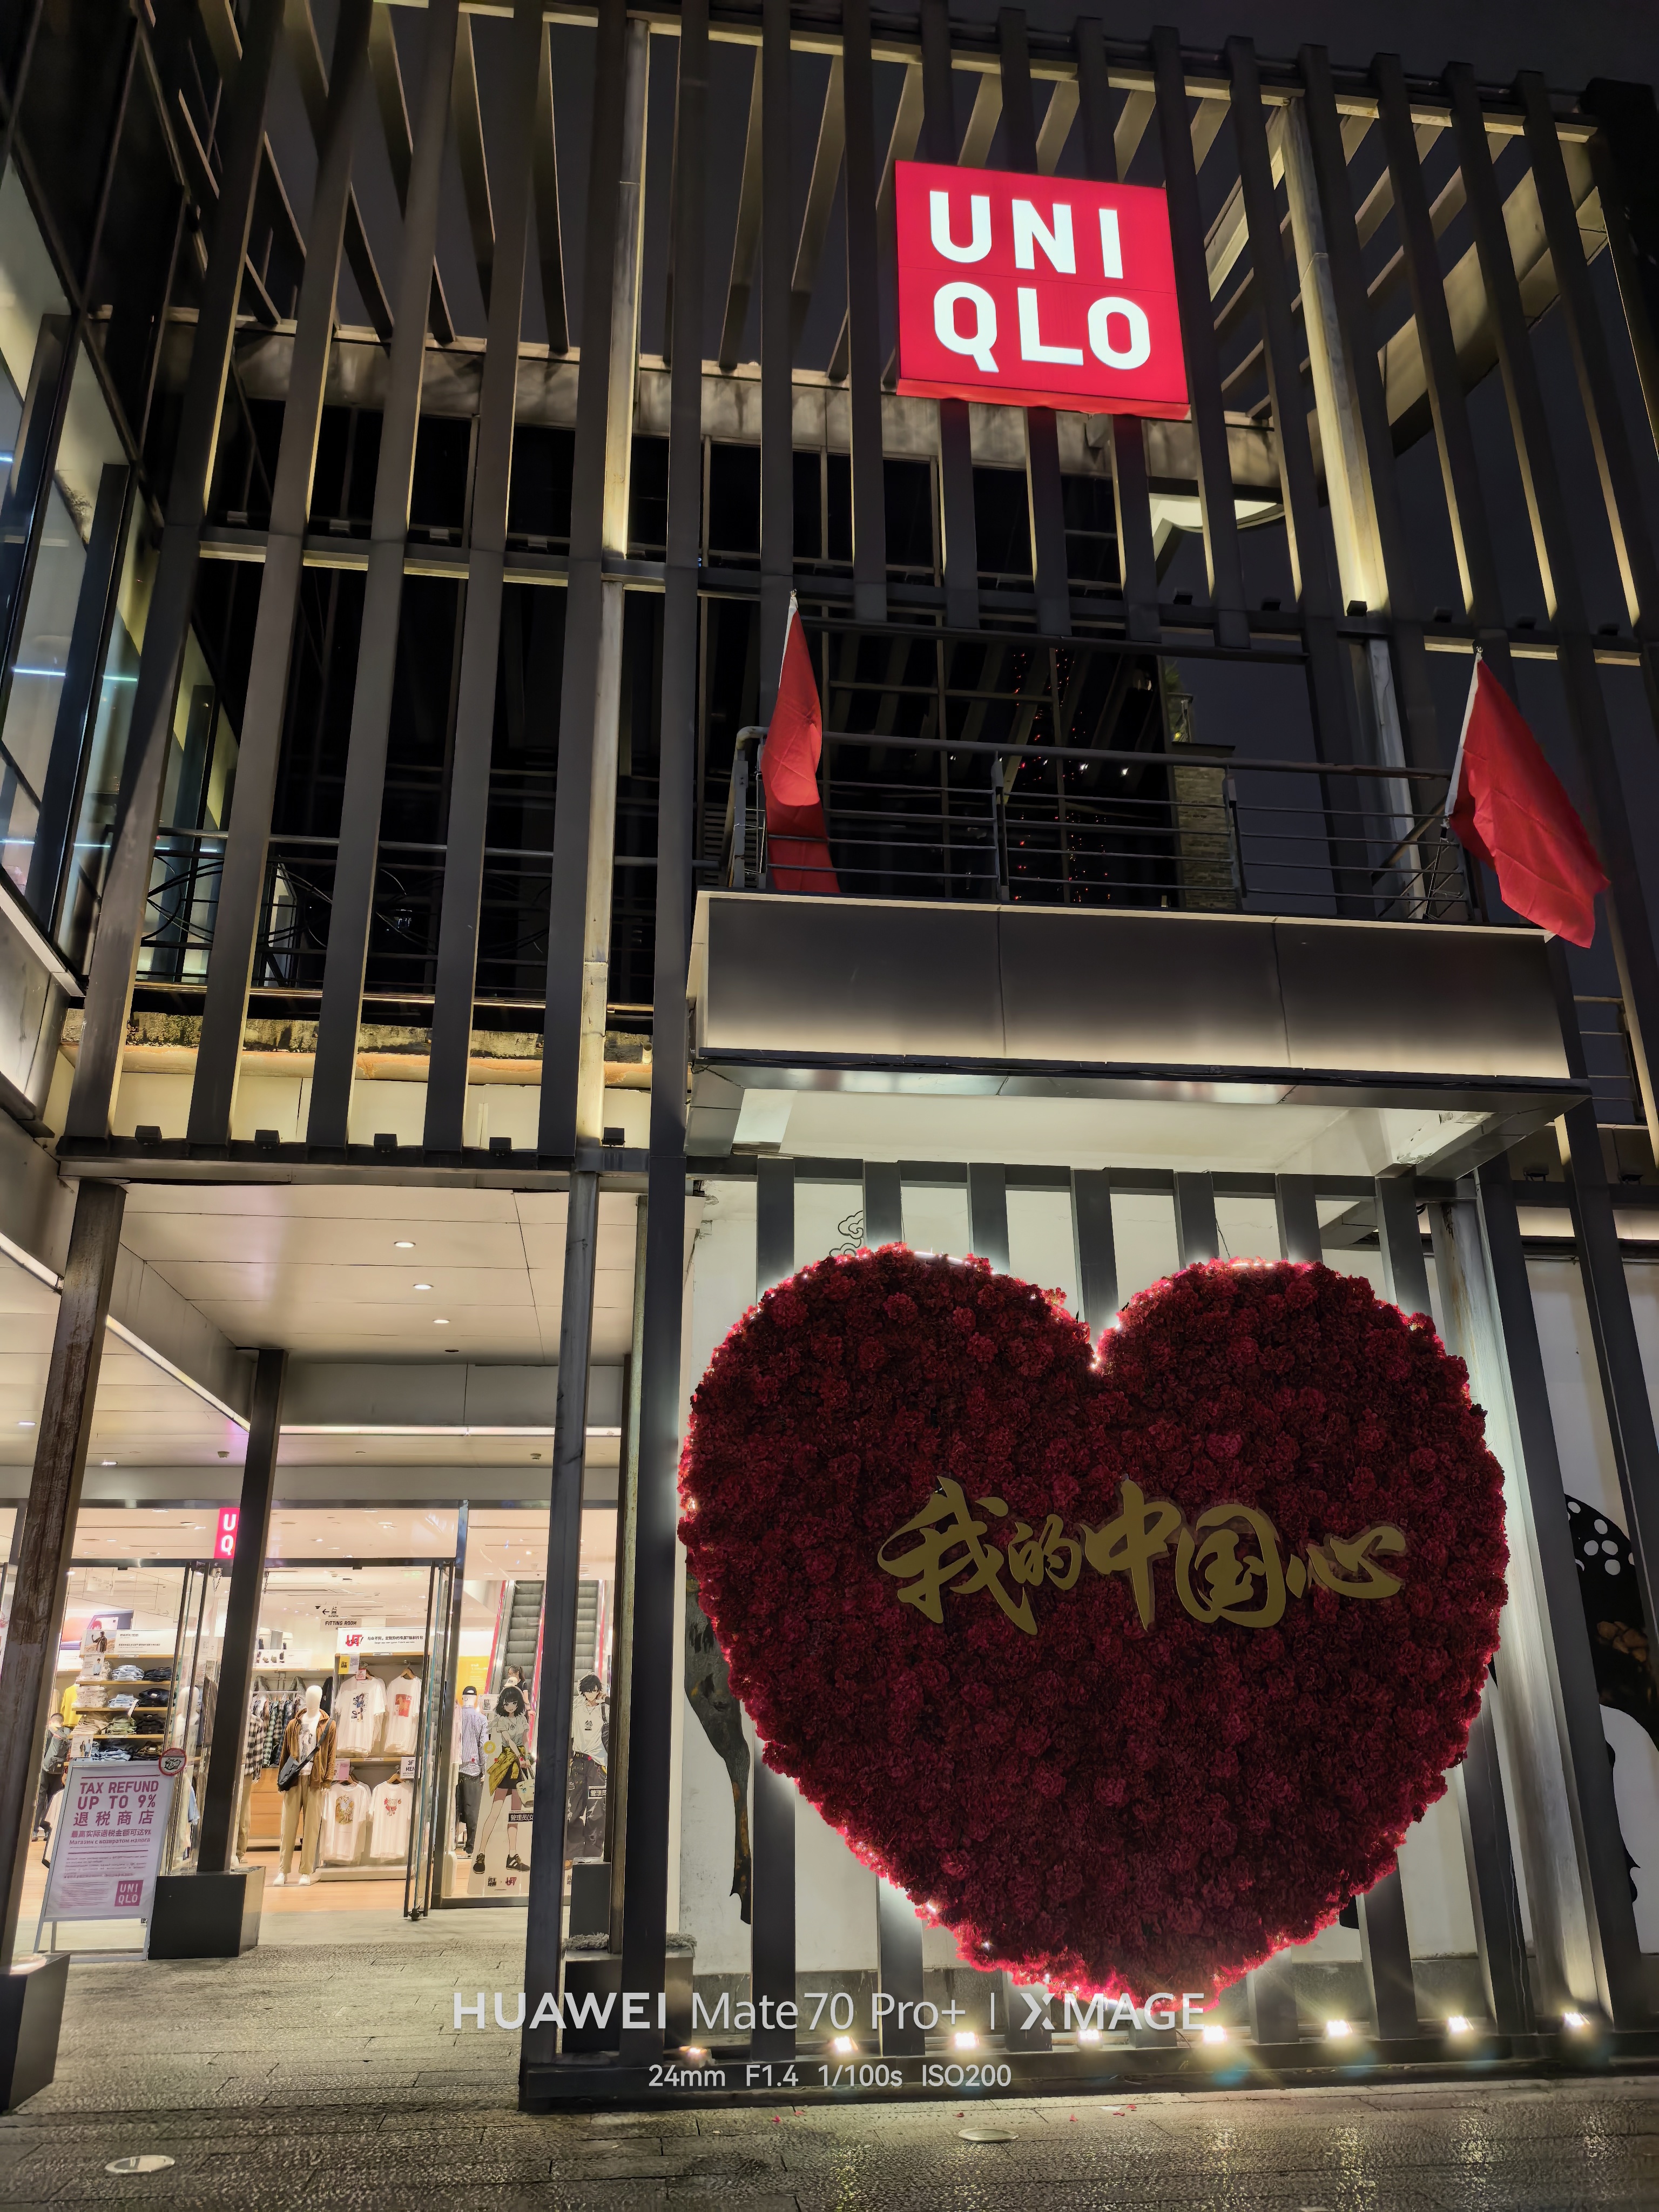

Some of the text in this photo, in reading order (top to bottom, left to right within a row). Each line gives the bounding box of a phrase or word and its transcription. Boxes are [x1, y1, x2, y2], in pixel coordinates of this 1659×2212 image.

[930, 191, 1123, 279] UNI
[933, 281, 1151, 373] QLO
[877, 1474, 1407, 1635] 我的中国心
[80, 1781, 159, 1795] TAX REFUND
[77, 1793, 157, 1810] UP TO 9%
[73, 1810, 154, 1826] 退税商店
[119, 1883, 138, 1893] UNI
[118, 1894, 138, 1905] QLO
